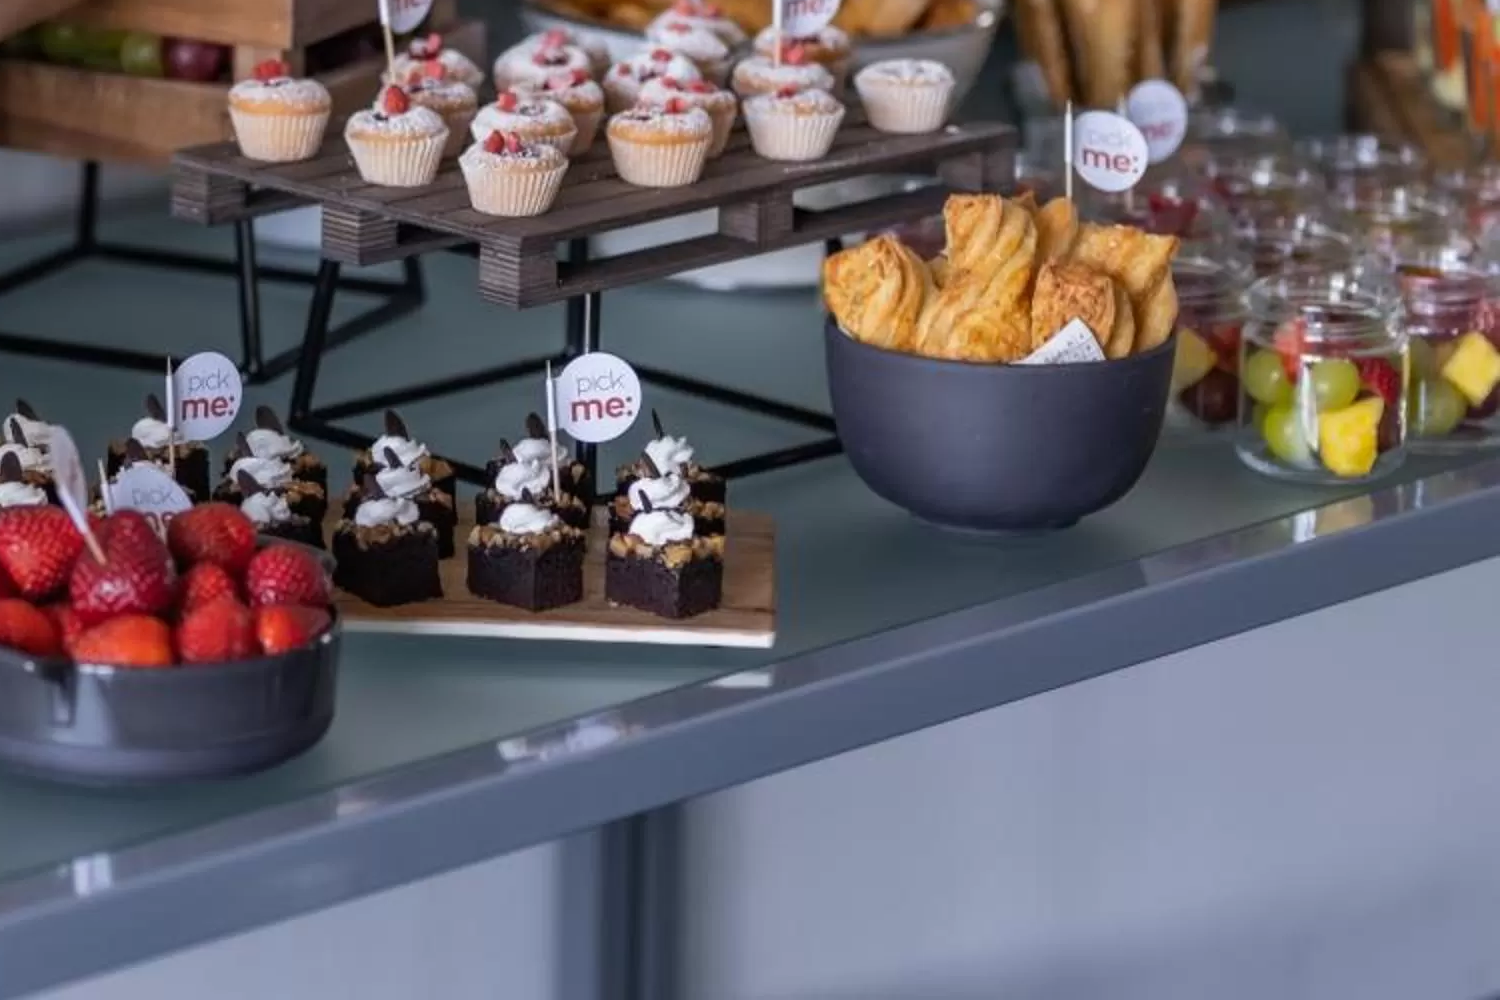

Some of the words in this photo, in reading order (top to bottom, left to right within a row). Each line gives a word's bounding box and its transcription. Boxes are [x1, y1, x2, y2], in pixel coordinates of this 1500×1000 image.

[1082, 147, 1139, 175] me:
[187, 367, 230, 395] pick
[576, 367, 625, 397] pick
[181, 395, 235, 421] me:
[571, 396, 633, 422] me:
